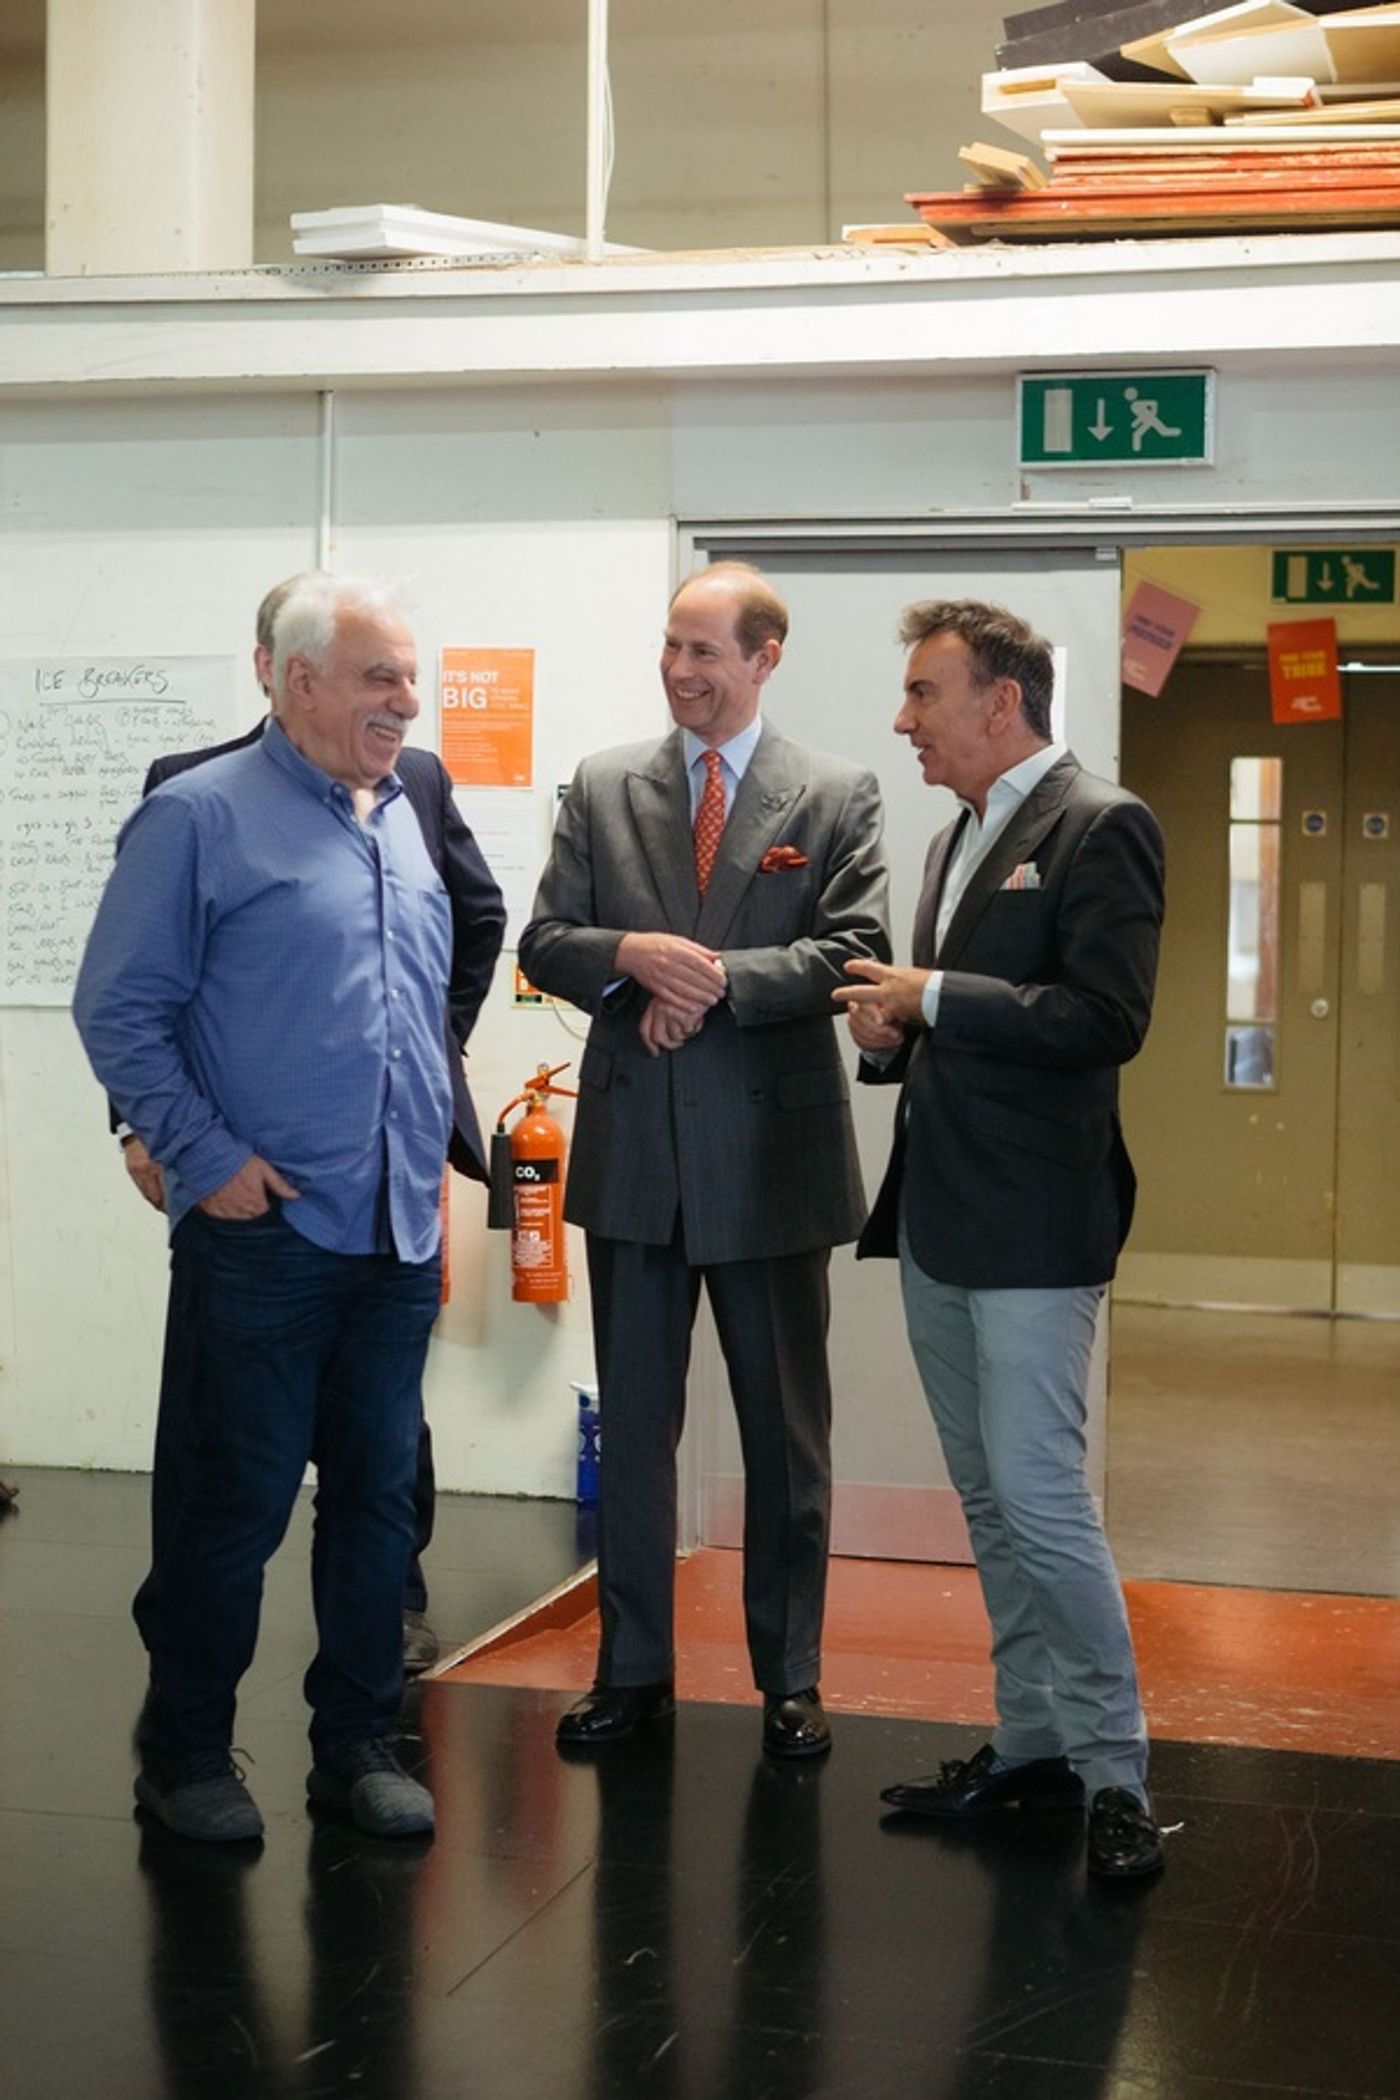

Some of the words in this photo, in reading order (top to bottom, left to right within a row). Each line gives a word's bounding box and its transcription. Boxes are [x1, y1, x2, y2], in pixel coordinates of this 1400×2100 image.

[35, 668, 65, 692] ICE
[443, 670, 468, 683] IT'S
[470, 670, 499, 684] NOT
[442, 687, 488, 709] BIG
